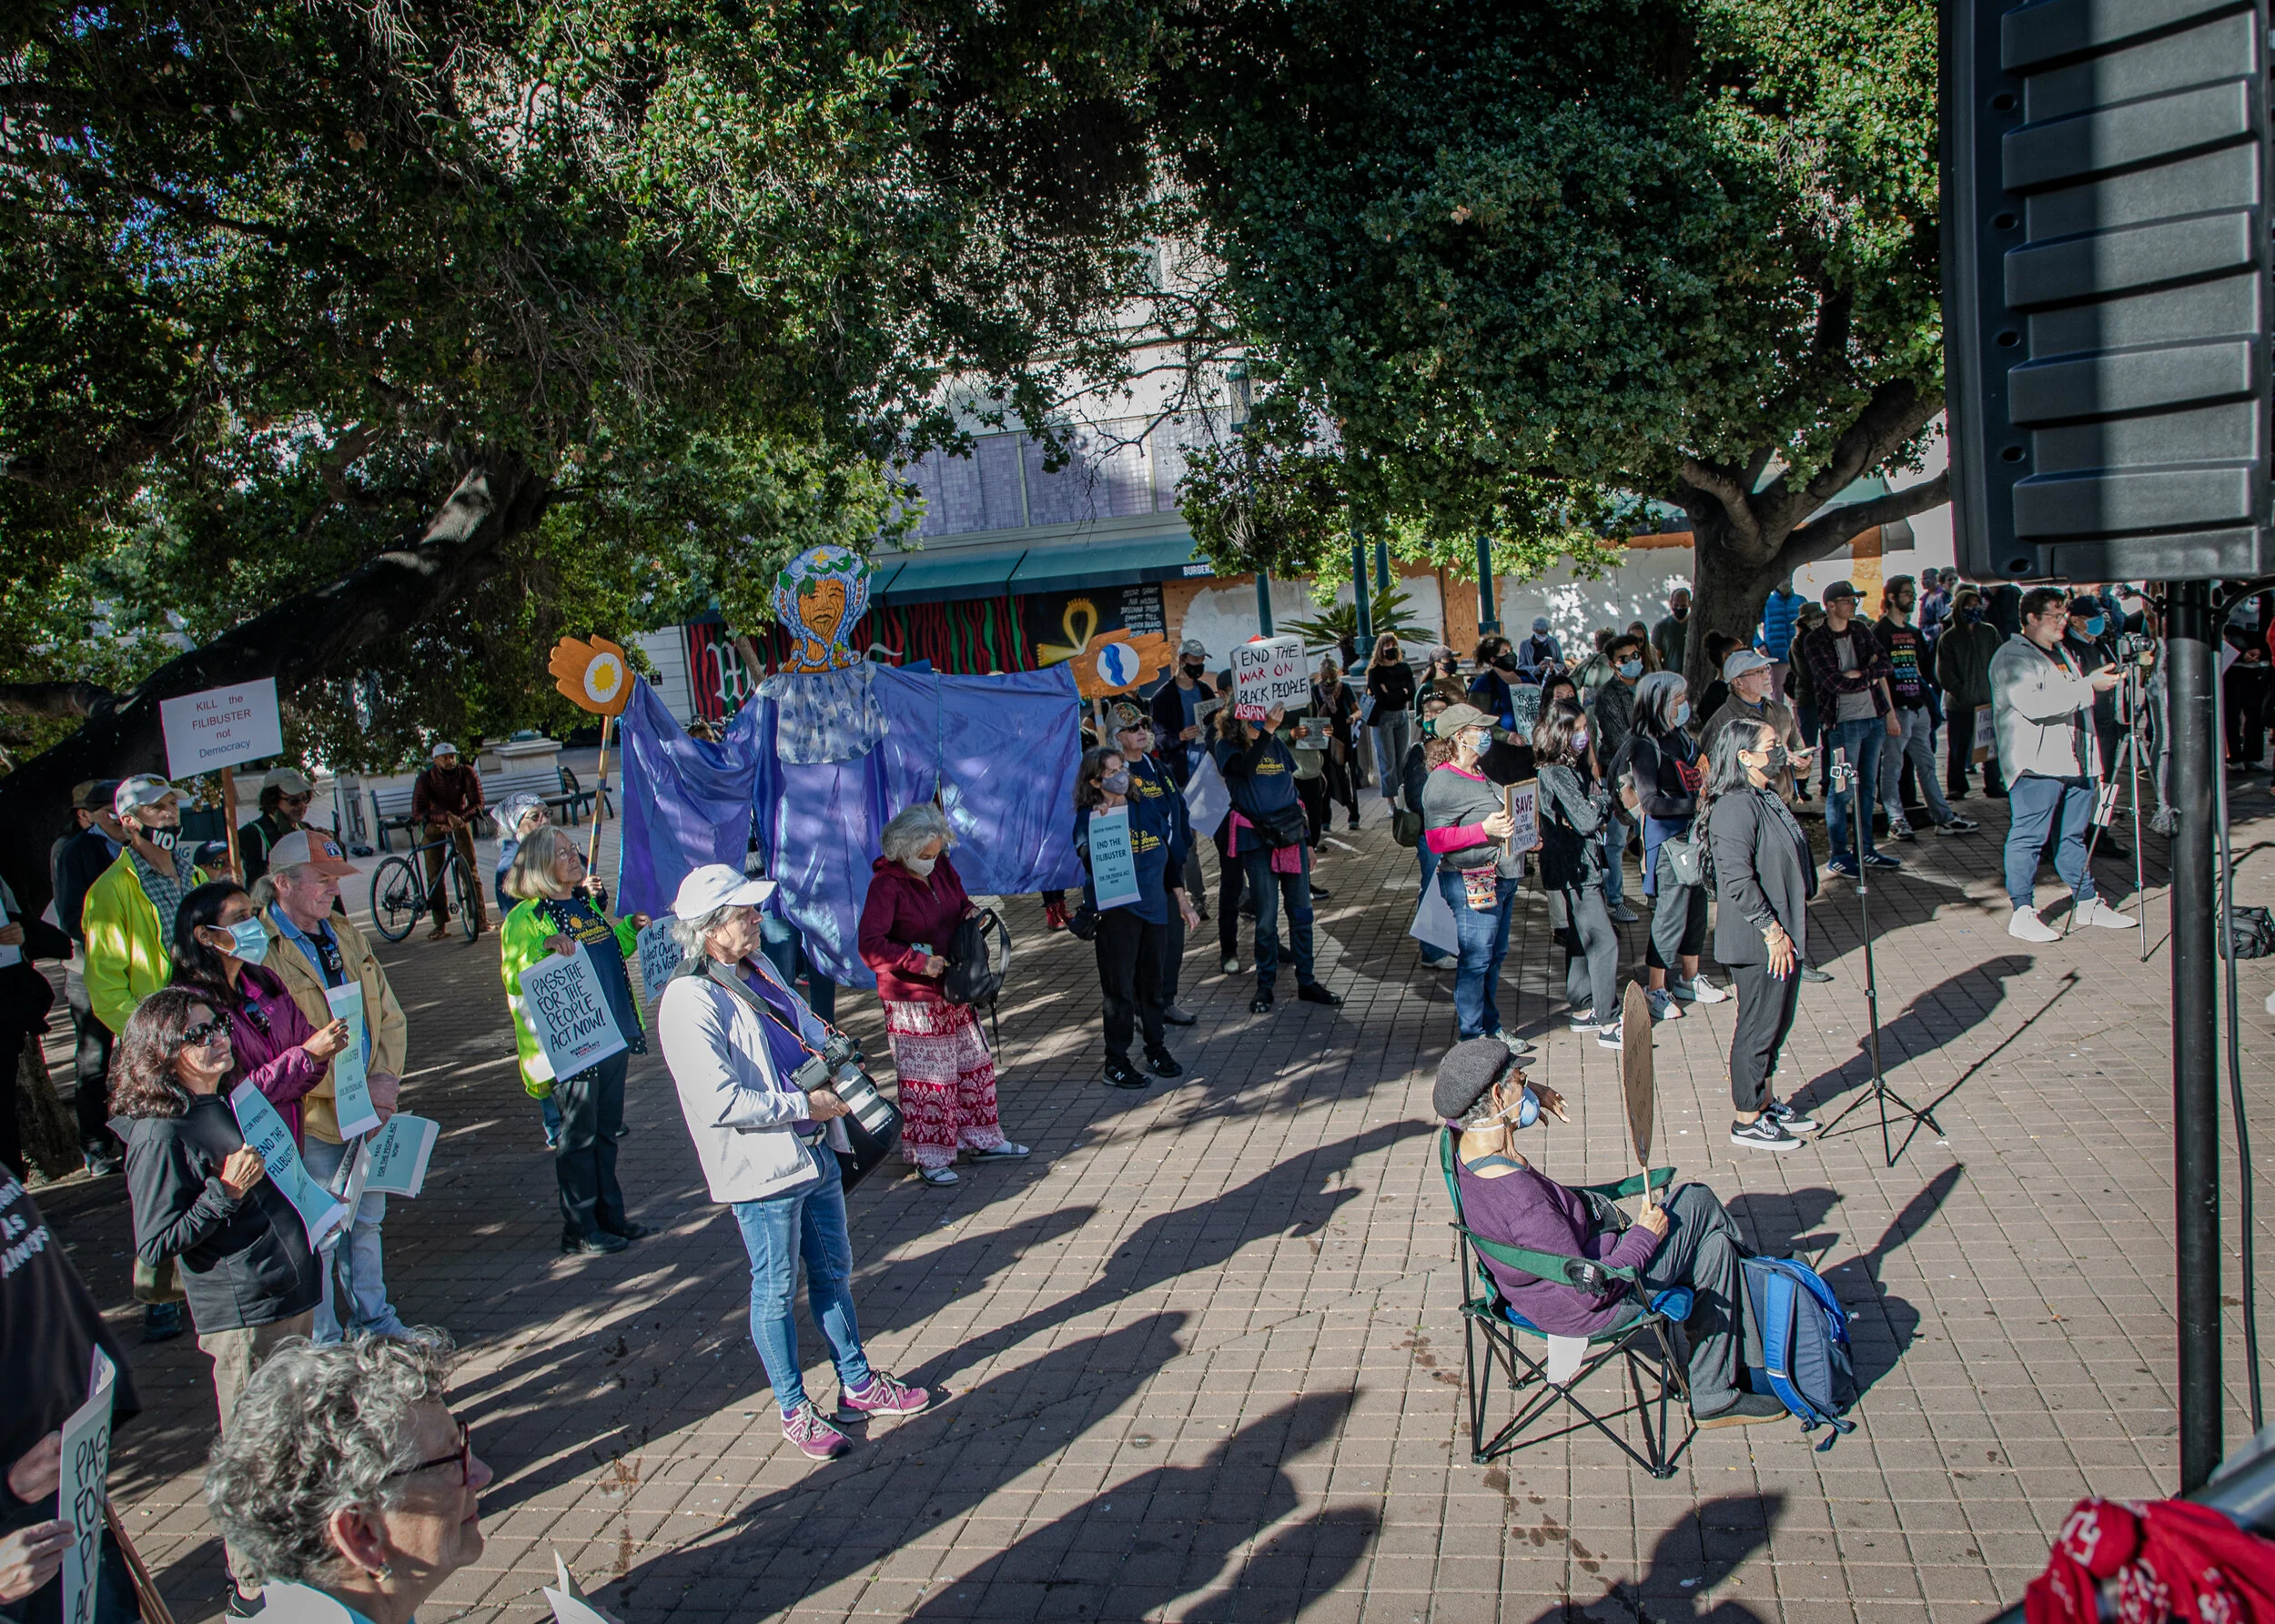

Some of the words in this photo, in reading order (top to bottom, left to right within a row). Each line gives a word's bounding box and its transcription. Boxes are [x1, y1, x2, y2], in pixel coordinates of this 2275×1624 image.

[1241, 649, 1269, 667] END
[1275, 644, 1299, 659] THE
[1239, 667, 1266, 684] WAR
[1274, 661, 1293, 676] ON
[1239, 686, 1269, 704] BLACK
[1271, 677, 1307, 699] PEOPLE
[196, 700, 217, 711] KILL
[228, 694, 244, 705] the
[1235, 703, 1265, 720] ASIAN
[192, 709, 251, 730] FILIBUSTER
[216, 729, 231, 740] not
[199, 740, 251, 759] Democracy
[1515, 794, 1532, 815] SAVE
[1097, 841, 1108, 850] END
[1110, 838, 1121, 846] THE
[1096, 849, 1127, 862] FILIBUSTER
[649, 923, 666, 943] Must
[659, 942, 676, 956] Our
[532, 969, 566, 997] PASS
[562, 961, 585, 983] THE
[537, 991, 565, 1015] FOR
[561, 980, 588, 1002] THE
[546, 994, 596, 1033] PEOPLE
[551, 1027, 571, 1052] ACT
[573, 1007, 607, 1041] NOW!
[389, 1122, 398, 1134] ACT
[257, 1138, 275, 1159] END
[271, 1126, 285, 1145] THE
[374, 1144, 382, 1157] PASS
[382, 1135, 394, 1155] PEOPLE
[380, 1155, 389, 1166] THE
[377, 1166, 386, 1177] FOR
